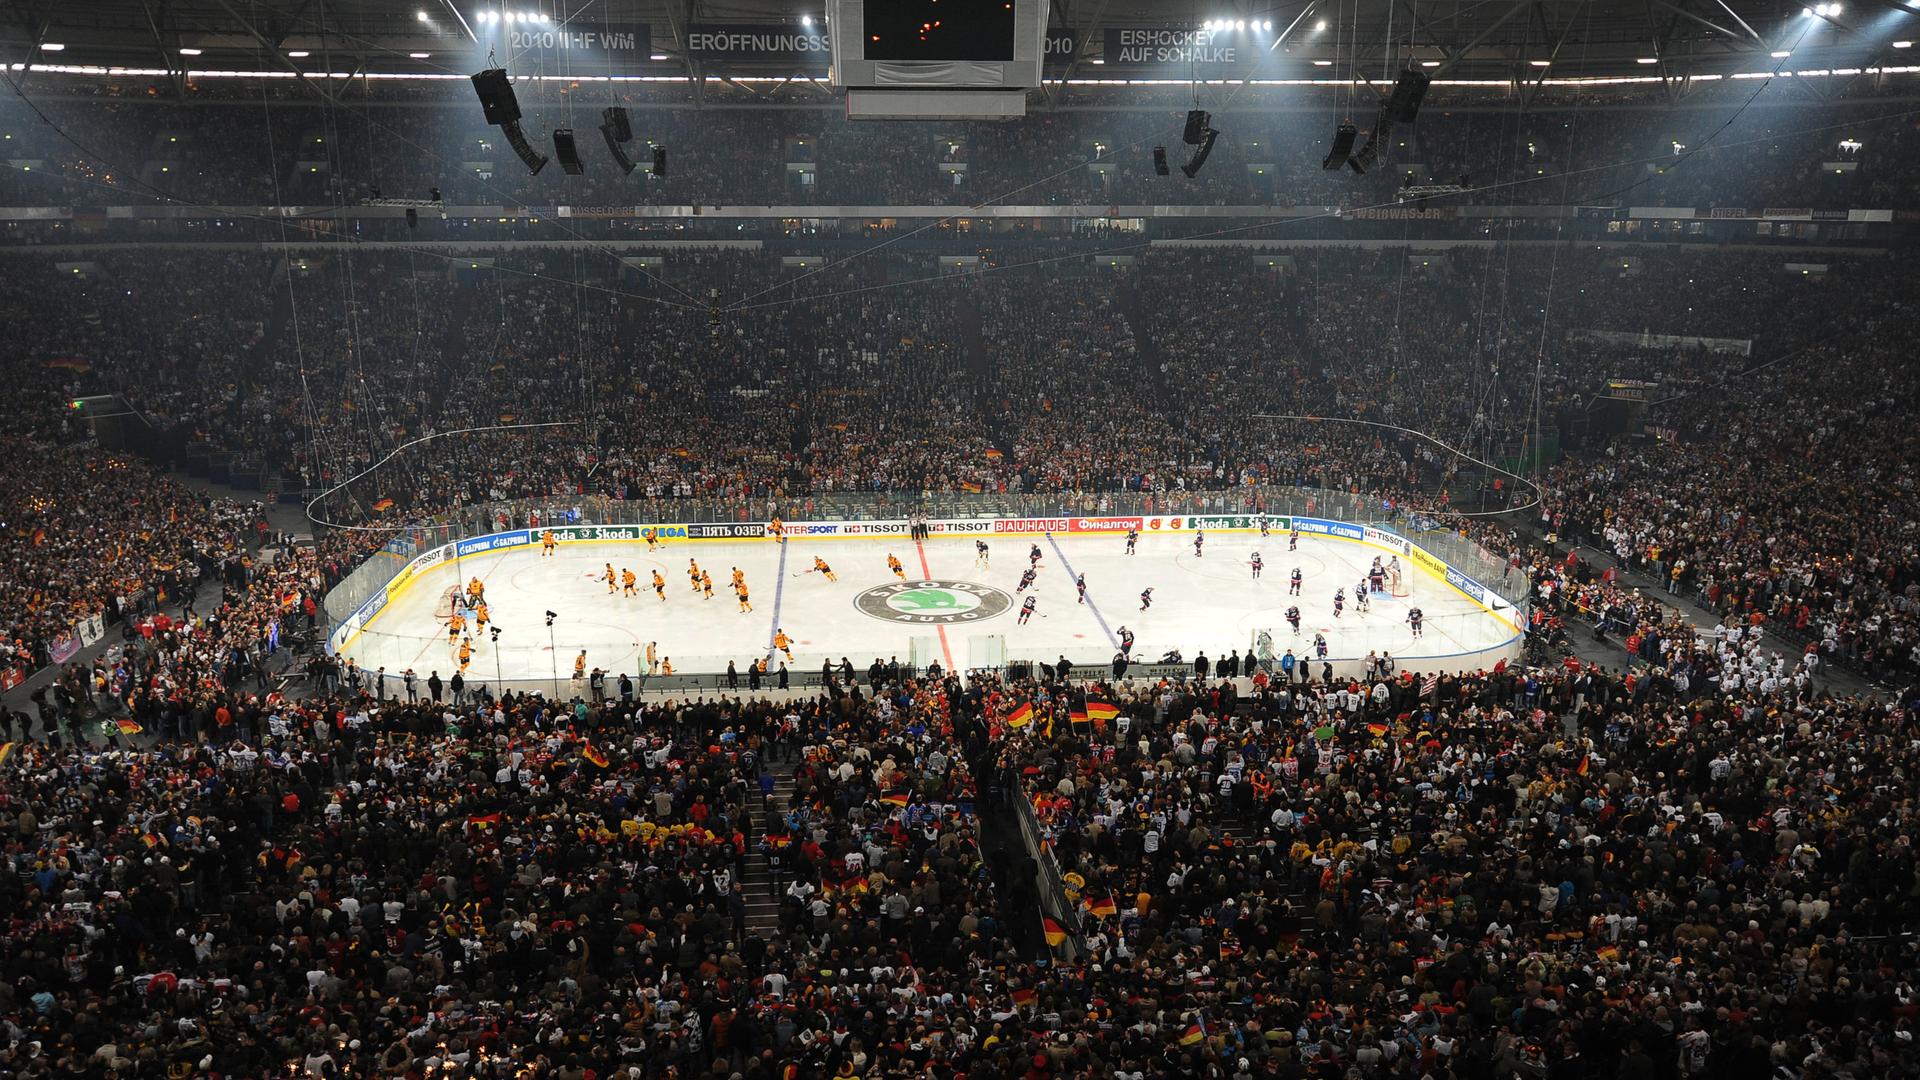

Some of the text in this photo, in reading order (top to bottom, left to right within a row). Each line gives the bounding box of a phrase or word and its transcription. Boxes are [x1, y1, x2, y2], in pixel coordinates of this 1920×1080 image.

[510, 32, 635, 49] 2010 IIHF WM
[689, 30, 830, 51] ERÖFFNUNGSS
[1120, 30, 1216, 46] EISHOCKEY
[1119, 47, 1235, 62] AUF SCHALKE
[862, 524, 907, 533] TISSOT
[946, 522, 991, 532] TISSOT
[995, 519, 1067, 532] BAUHAUS
[1377, 532, 1403, 547] TISSOT
[418, 551, 441, 566] TISSOT
[895, 612, 979, 622] AUTO
[769, 856, 780, 866] 10
